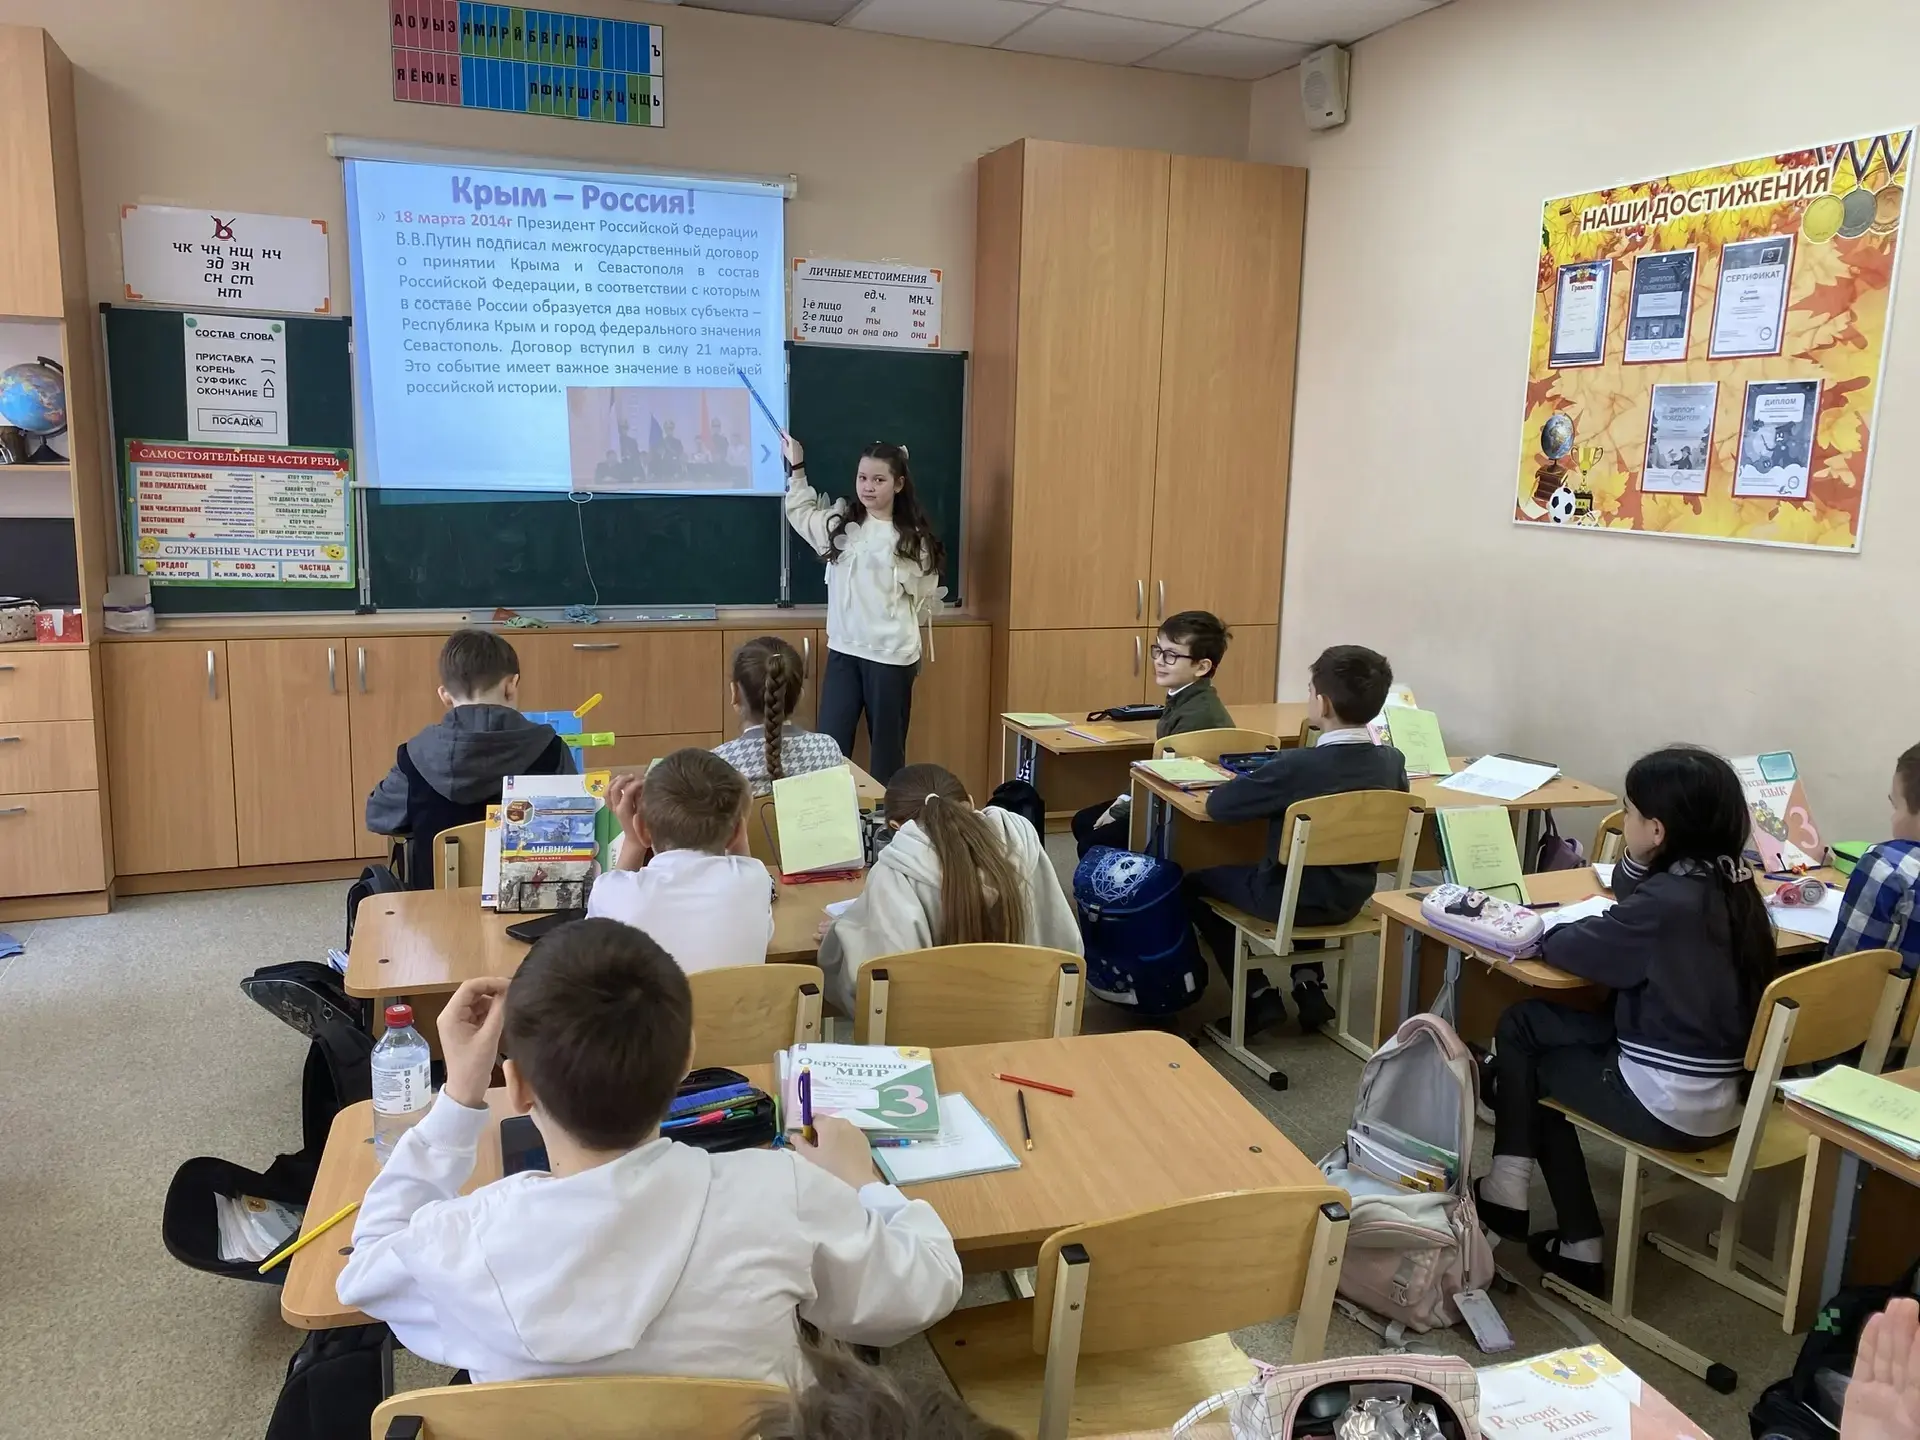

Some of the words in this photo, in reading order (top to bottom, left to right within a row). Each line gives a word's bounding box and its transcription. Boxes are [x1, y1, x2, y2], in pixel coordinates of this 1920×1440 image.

[395, 14, 403, 27] А
[408, 16, 416, 27] О
[421, 18, 428, 29] У
[433, 19, 444, 30] Ы
[448, 20, 455, 32] Э
[463, 22, 470, 32] Н
[474, 24, 485, 36] М
[489, 25, 497, 37] Л
[501, 26, 508, 39] Р
[515, 24, 521, 40] Й
[529, 31, 536, 42] Б
[541, 32, 548, 44] В
[554, 33, 560, 45] Г
[566, 35, 575, 47] Д
[576, 37, 588, 48] Ж
[591, 37, 597, 49] З
[651, 45, 661, 56] Ъ
[397, 69, 405, 80] Я
[411, 68, 417, 82] Ё
[422, 71, 433, 82] Ю
[437, 73, 445, 84] И
[451, 74, 457, 86] Е
[530, 83, 537, 94] П
[541, 84, 552, 96] Ф
[556, 85, 562, 96] К
[568, 86, 574, 97] Т
[578, 88, 588, 99] Ш
[592, 89, 599, 100] С
[606, 90, 612, 101] Х
[617, 91, 625, 104] Ц
[630, 92, 637, 104] Ч
[639, 94, 650, 107] Щ
[653, 95, 660, 106] Ь
[451, 176, 547, 211] Крым
[582, 184, 695, 215] Россия!
[1583, 201, 1646, 231] НАШИ
[1652, 167, 1831, 224] ДОСТИЖЕНИЯ
[394, 210, 413, 224] 18
[418, 213, 465, 228] марта
[471, 214, 513, 228] 2014г
[517, 216, 595, 233] Президент
[600, 220, 679, 235] Российской
[683, 224, 758, 240] Федерации
[173, 243, 193, 253] чк
[201, 245, 220, 255] чн
[229, 247, 253, 259] нщ
[262, 249, 281, 259] нч
[396, 232, 471, 249] В.В.Путин
[476, 237, 546, 252] подписал
[551, 240, 700, 258] межгосударственный
[705, 247, 759, 261] договор
[206, 257, 224, 269] зд
[232, 262, 250, 271] зн
[397, 257, 406, 266] о
[423, 255, 495, 272] принятии
[511, 258, 559, 273] Крыма
[574, 263, 583, 272] и
[598, 261, 683, 276] Севастополя
[698, 267, 705, 276] в
[718, 267, 759, 278] состав
[809, 267, 852, 277] ЛИЧНЫЕ
[854, 271, 927, 283] МЕСТОИМЕНИЯ
[1726, 271, 1780, 282] СЕРТИФИКАТ
[400, 275, 486, 291] Российской
[492, 278, 580, 294] Федерации,
[585, 283, 592, 292] в
[597, 284, 687, 296] соответствии
[691, 287, 698, 295] с
[703, 286, 760, 299] которым
[864, 290, 886, 300] ед.ч.
[401, 300, 408, 309] в
[414, 299, 472, 312] составе
[477, 299, 528, 313] России
[532, 300, 611, 316] образуется
[616, 305, 640, 318] два
[645, 306, 686, 317] новых
[691, 306, 748, 321] субъекта
[803, 298, 815, 309] 1-е
[817, 301, 841, 310] лицо
[802, 311, 816, 321] 2-е
[819, 314, 843, 322] лицо
[195, 329, 235, 338] СОСТАВ
[240, 332, 274, 341] СЛОВА
[403, 318, 489, 335] Республика
[495, 320, 536, 335] Крым
[540, 324, 549, 333] и
[554, 323, 595, 336] город
[600, 322, 696, 339] федерального
[701, 326, 760, 337] значения
[802, 323, 816, 332] 3-е
[819, 326, 842, 334] лицо
[403, 339, 502, 354] Севастополь.
[511, 341, 571, 356] Договор
[580, 343, 634, 357] вступил
[643, 345, 650, 354] в
[658, 345, 688, 357] силу
[696, 343, 712, 355] 21
[720, 347, 761, 359] марта.
[196, 353, 254, 363] ПРИСТАВКА
[405, 360, 431, 373] Это
[437, 360, 500, 374] событие
[507, 363, 550, 374] имеет
[556, 363, 609, 375] важное
[615, 363, 678, 375] значение
[684, 365, 691, 375] в
[696, 361, 761, 376] новейшей
[197, 376, 247, 385] СУФФИКС
[406, 379, 493, 396] российской
[497, 382, 561, 396] истории.
[197, 388, 258, 397] ОКОНЧАНИЕ
[1764, 398, 1796, 406] ДИПЛОМ
[213, 417, 262, 426] ПОСАДКА
[140, 449, 266, 463] САМОСТОЯТЕЛЬНЫЕ
[268, 455, 308, 465] ЧАСТИ
[311, 458, 339, 467] РЕЧИ
[155, 471, 213, 479] СУЩЕСТВИТЕЛЬНОЕ
[155, 482, 207, 490] ПРИЛАГАТЕЛЬНОЕ
[165, 546, 240, 555] СЛУЖЕБНЫЕ
[244, 548, 282, 556] ЧАСТИ
[1760, 786, 1787, 798] ЯЗЫК
[1790, 806, 1818, 848] 3
[798, 1058, 907, 1069] Окружающий
[836, 1068, 889, 1077] МИР
[881, 1085, 928, 1117] 3
[1486, 1405, 1561, 1431] Русский
[1543, 1410, 1599, 1433] ЯЗЫК
